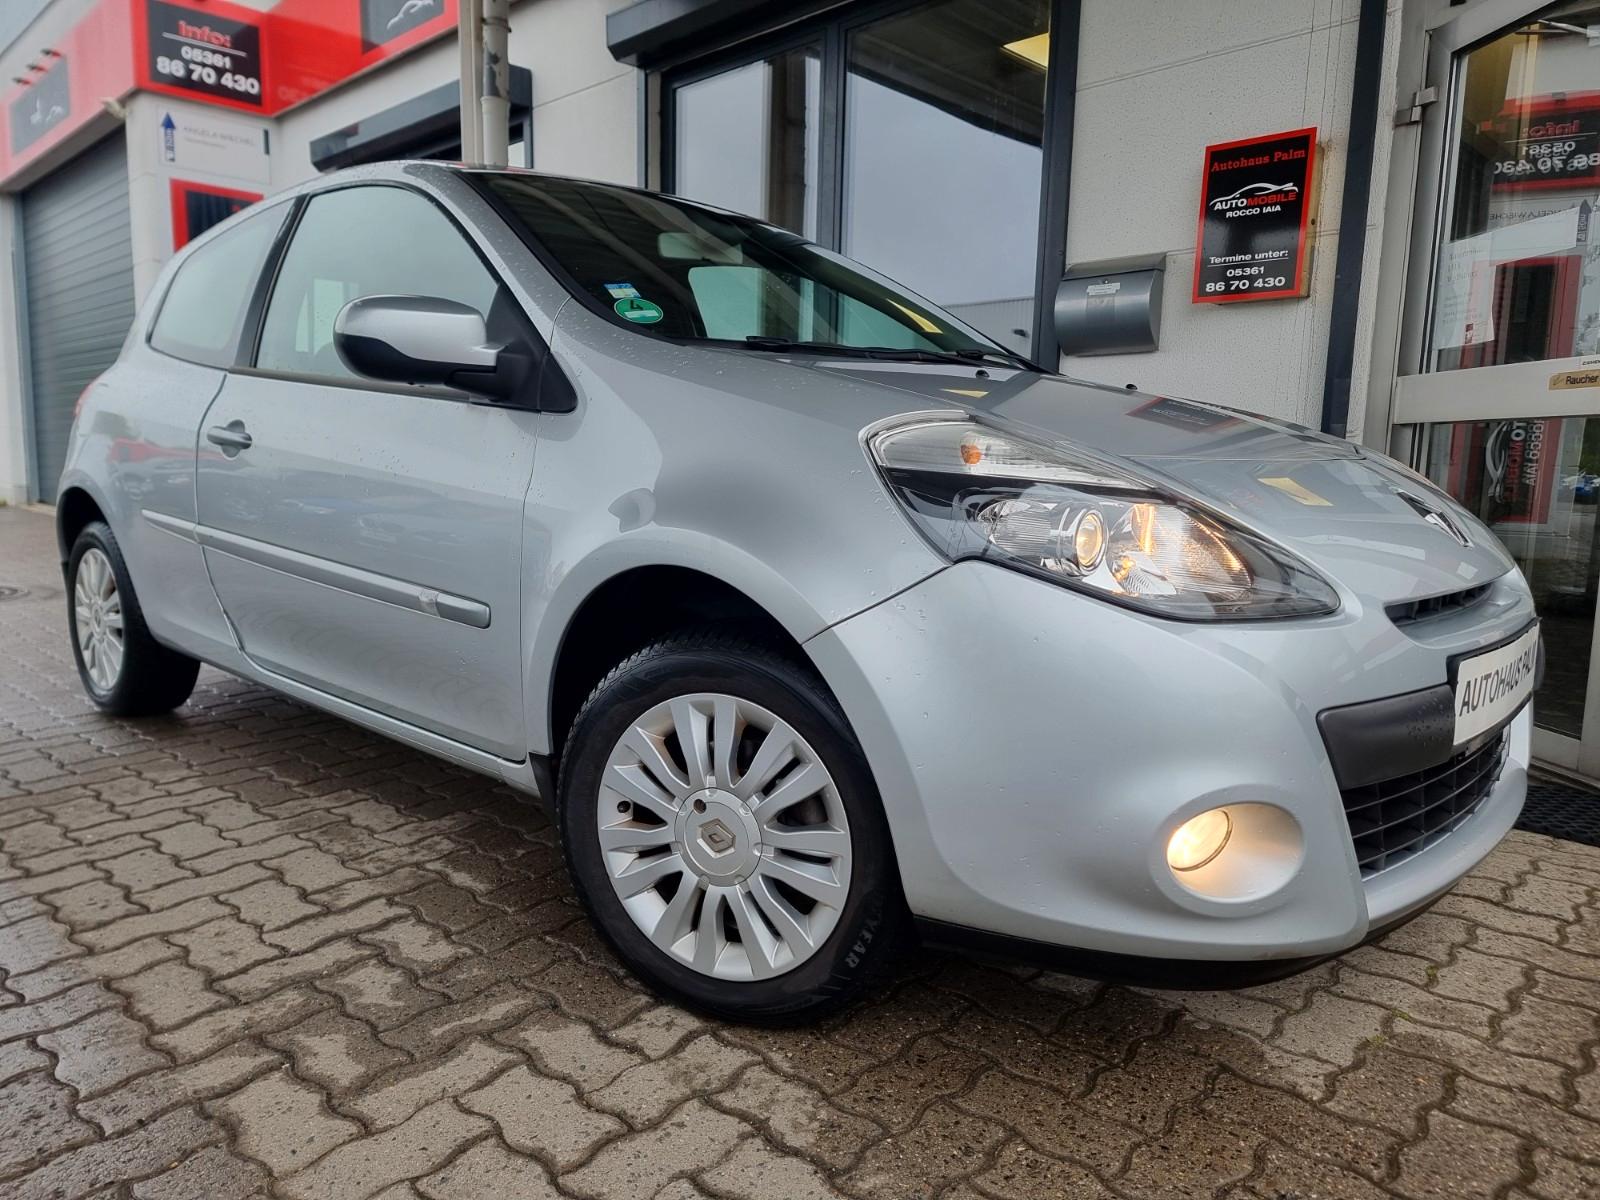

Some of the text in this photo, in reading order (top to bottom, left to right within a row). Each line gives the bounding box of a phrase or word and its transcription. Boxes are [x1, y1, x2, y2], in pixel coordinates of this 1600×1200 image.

[178, 20, 232, 48] Info:
[181, 45, 232, 70] 05361
[157, 55, 186, 78] 86
[189, 63, 217, 85] 70
[220, 72, 260, 95] 430
[1211, 148, 1306, 172] Autohaus Palm
[1213, 192, 1297, 211] AUTOMOBILE
[1226, 205, 1282, 218] ROCCO IAIA
[1209, 250, 1288, 264] Termine unter:
[1226, 266, 1265, 277] 05361
[1205, 276, 1286, 292] 86 70 430
[1566, 375, 1599, 385] Raucher
[1459, 655, 1523, 717] AUTOHAUS
